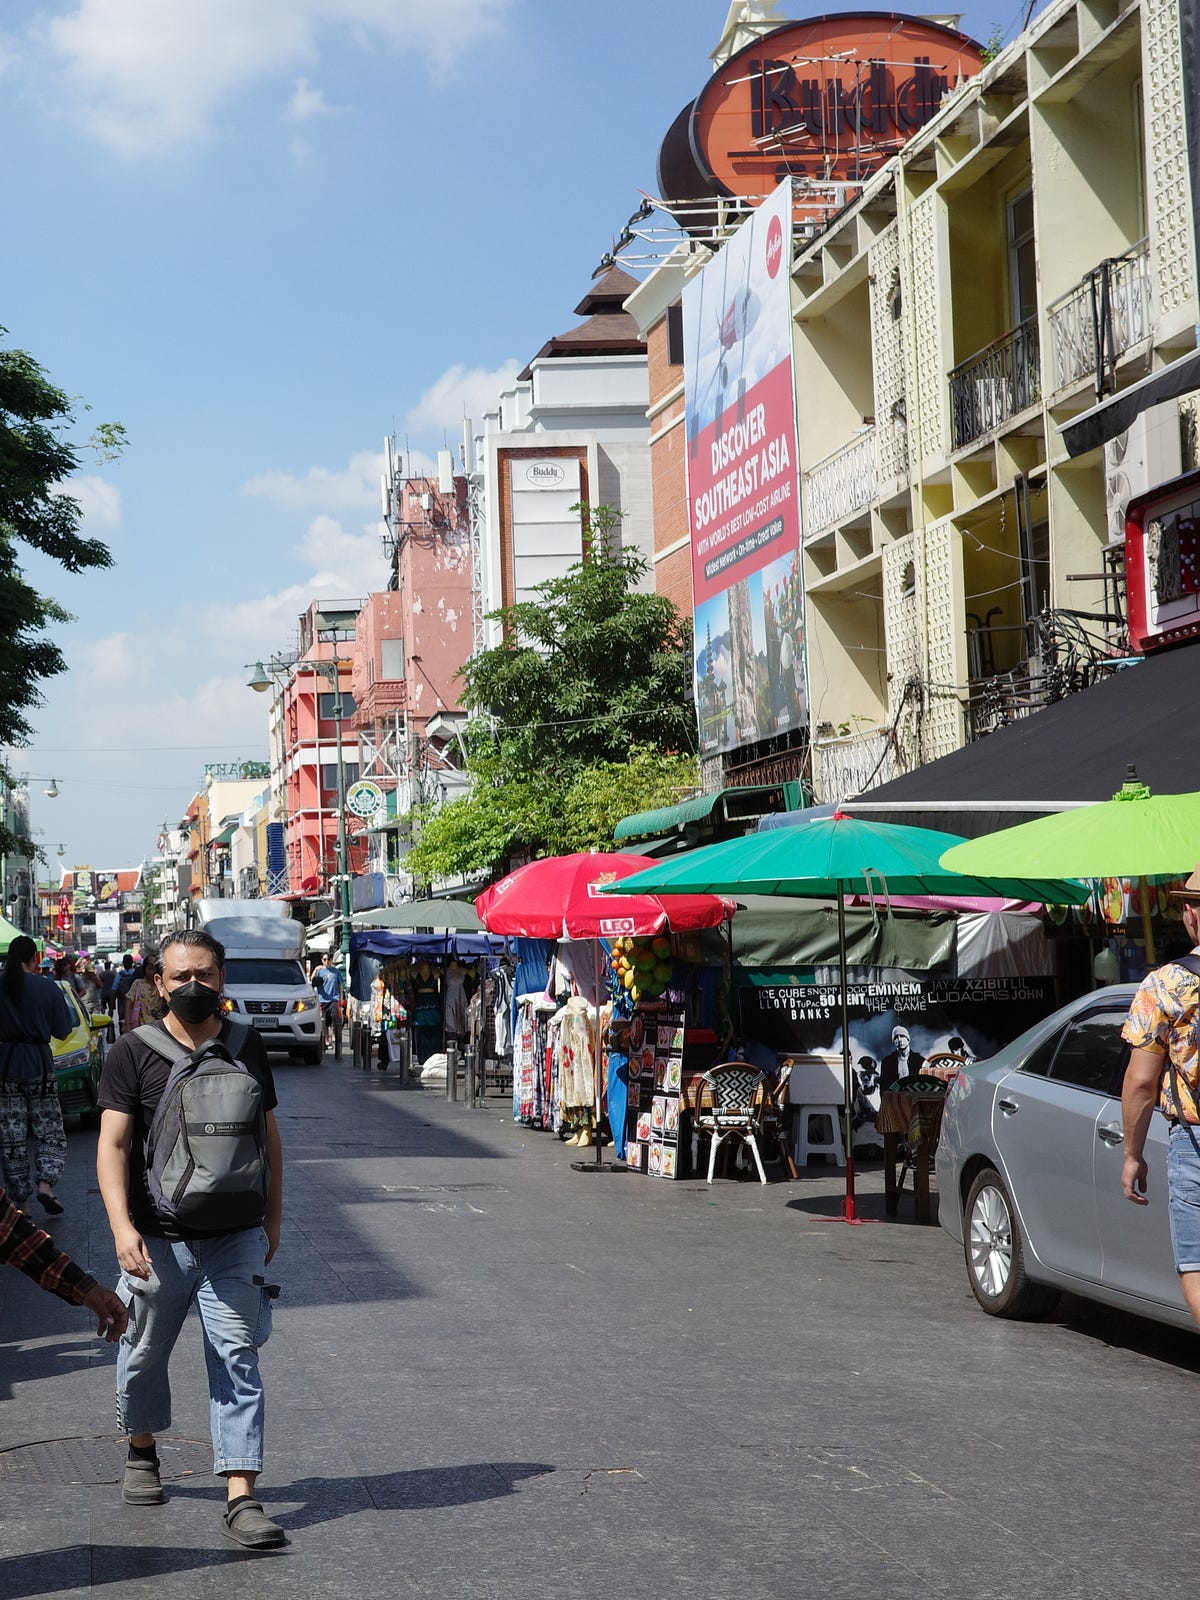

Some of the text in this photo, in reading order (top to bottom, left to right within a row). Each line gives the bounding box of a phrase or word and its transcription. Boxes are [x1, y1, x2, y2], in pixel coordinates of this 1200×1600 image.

[711, 403, 766, 475] DISCOVER
[533, 466, 557, 477] Buddy
[695, 433, 790, 530] SOUTHEAST ASIA
[696, 481, 791, 555] WITH WORLD'S BEST LOW-COST AIRLINE
[602, 920, 633, 933] LEO
[759, 990, 775, 999] ICE
[779, 988, 806, 998] CUBE
[807, 987, 837, 996] SNOPP
[868, 983, 921, 996] EMINEM
[965, 978, 1009, 990] XZIBIT
[1010, 978, 1029, 989] LIL
[760, 998, 795, 1009] LLOYD
[820, 994, 836, 1007] 50
[927, 990, 1010, 1003] LUDACRIS
[1011, 989, 1043, 1000] JOHN
[866, 1002, 927, 1012] THE GAME
[791, 1008, 830, 1020] BANKS
